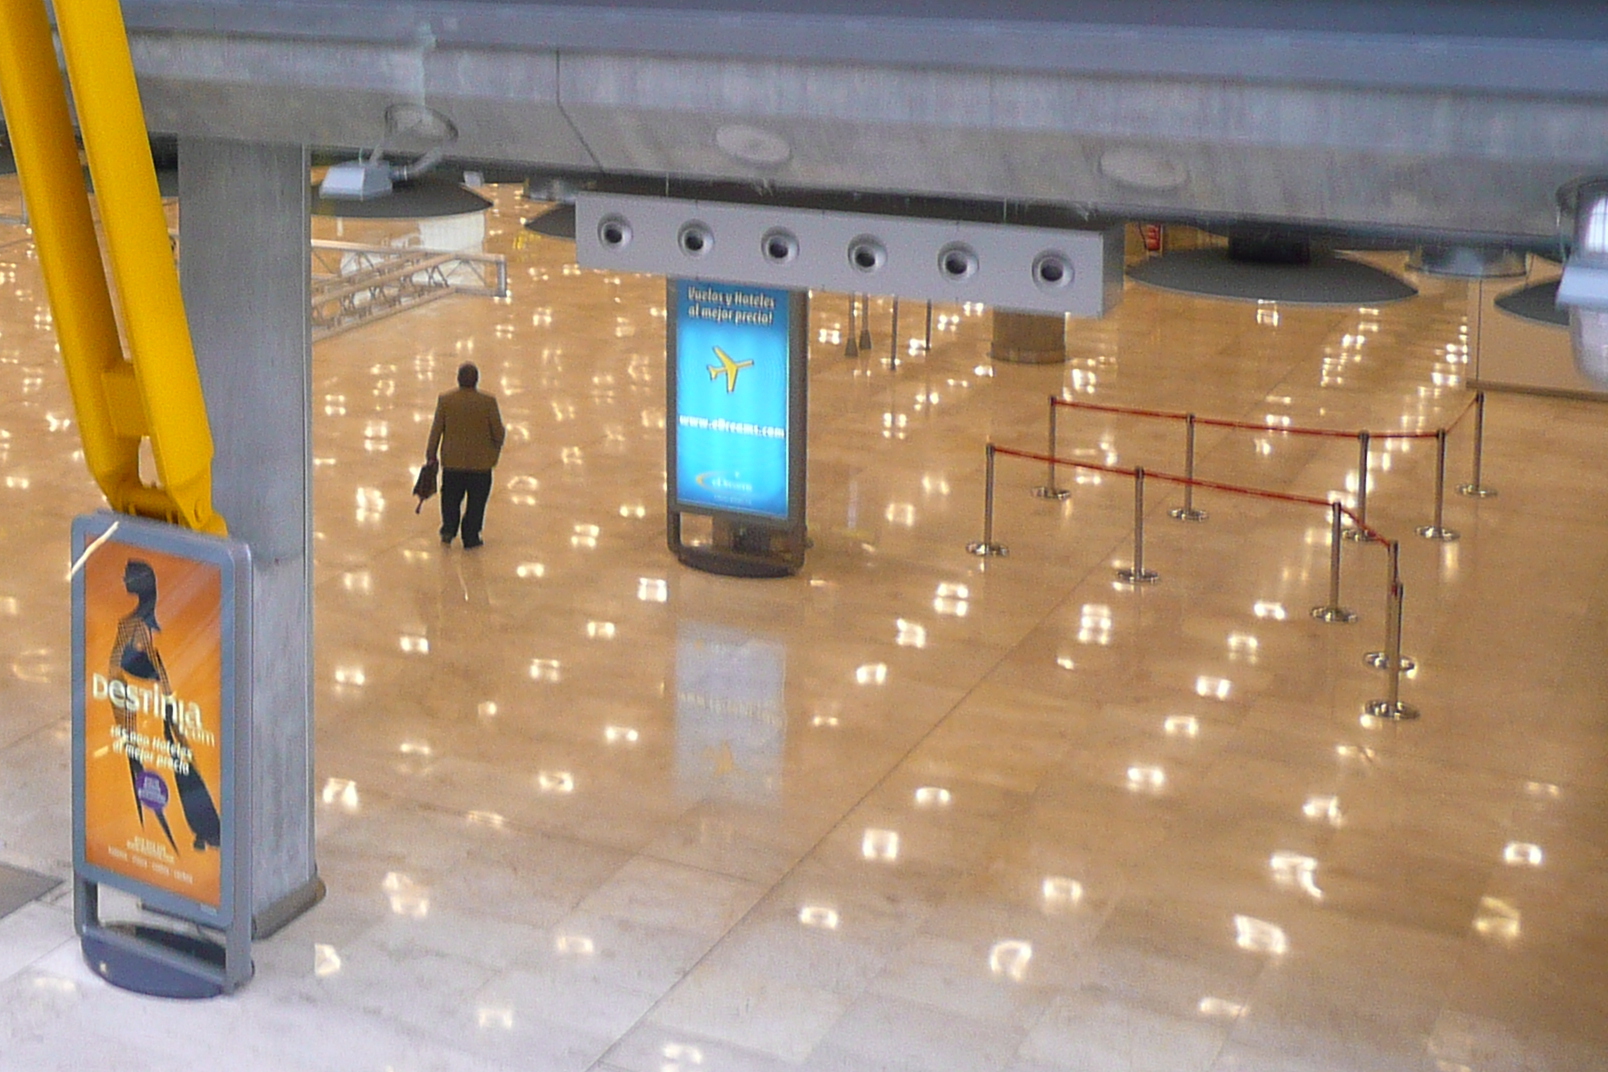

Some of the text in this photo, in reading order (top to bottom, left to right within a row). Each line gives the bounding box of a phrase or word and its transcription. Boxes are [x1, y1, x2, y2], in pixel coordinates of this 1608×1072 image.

[688, 286, 774, 309] Vuelos y Hoteles
[688, 303, 699, 319] al
[701, 305, 733, 324] mejor
